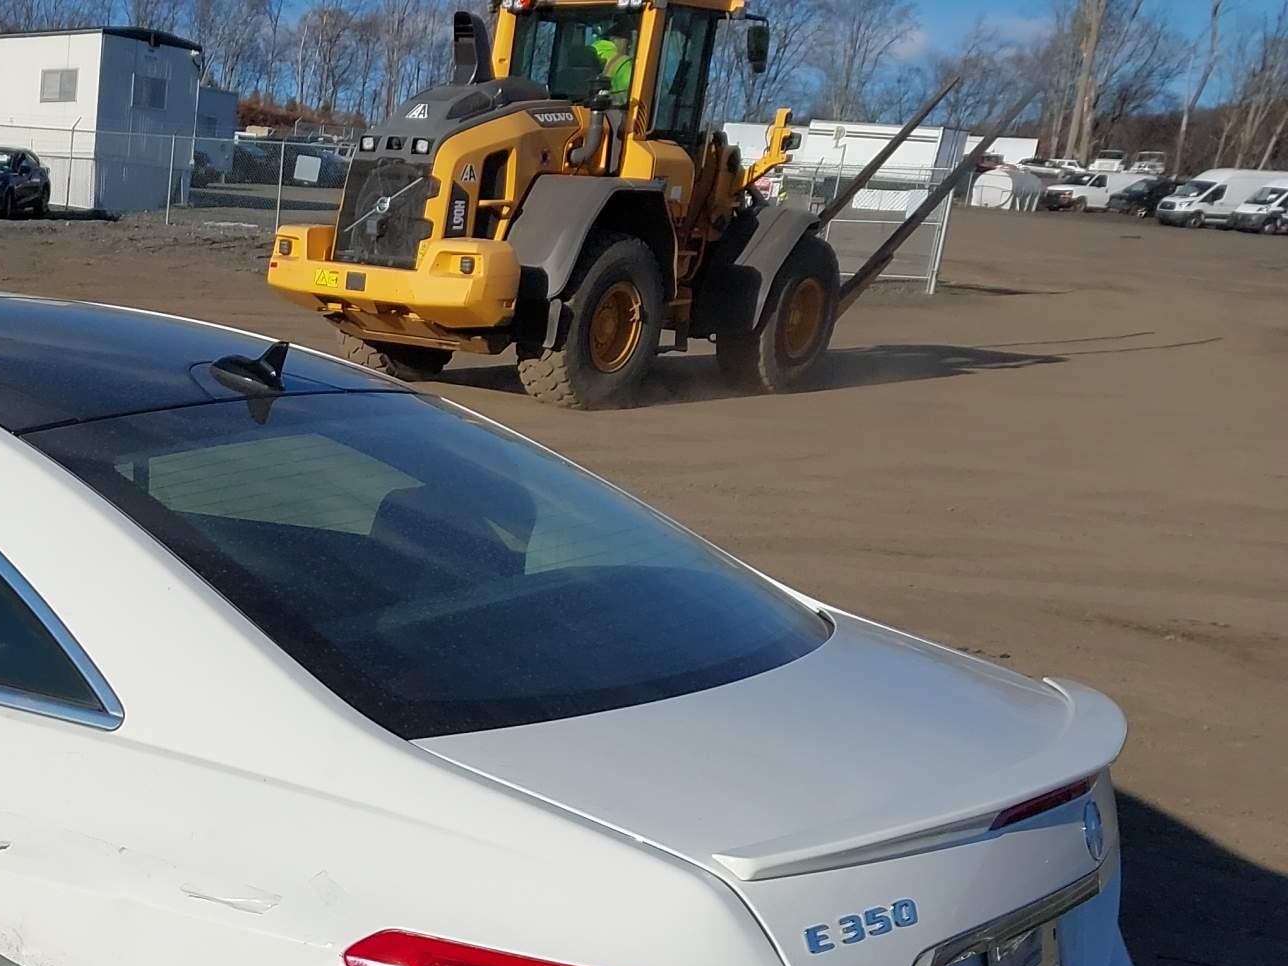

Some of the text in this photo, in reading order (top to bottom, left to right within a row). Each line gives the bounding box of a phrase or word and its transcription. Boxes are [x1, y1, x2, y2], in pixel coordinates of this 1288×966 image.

[534, 112, 574, 123] VOLVO
[452, 200, 466, 230] L90H
[804, 899, 918, 954] E 350
